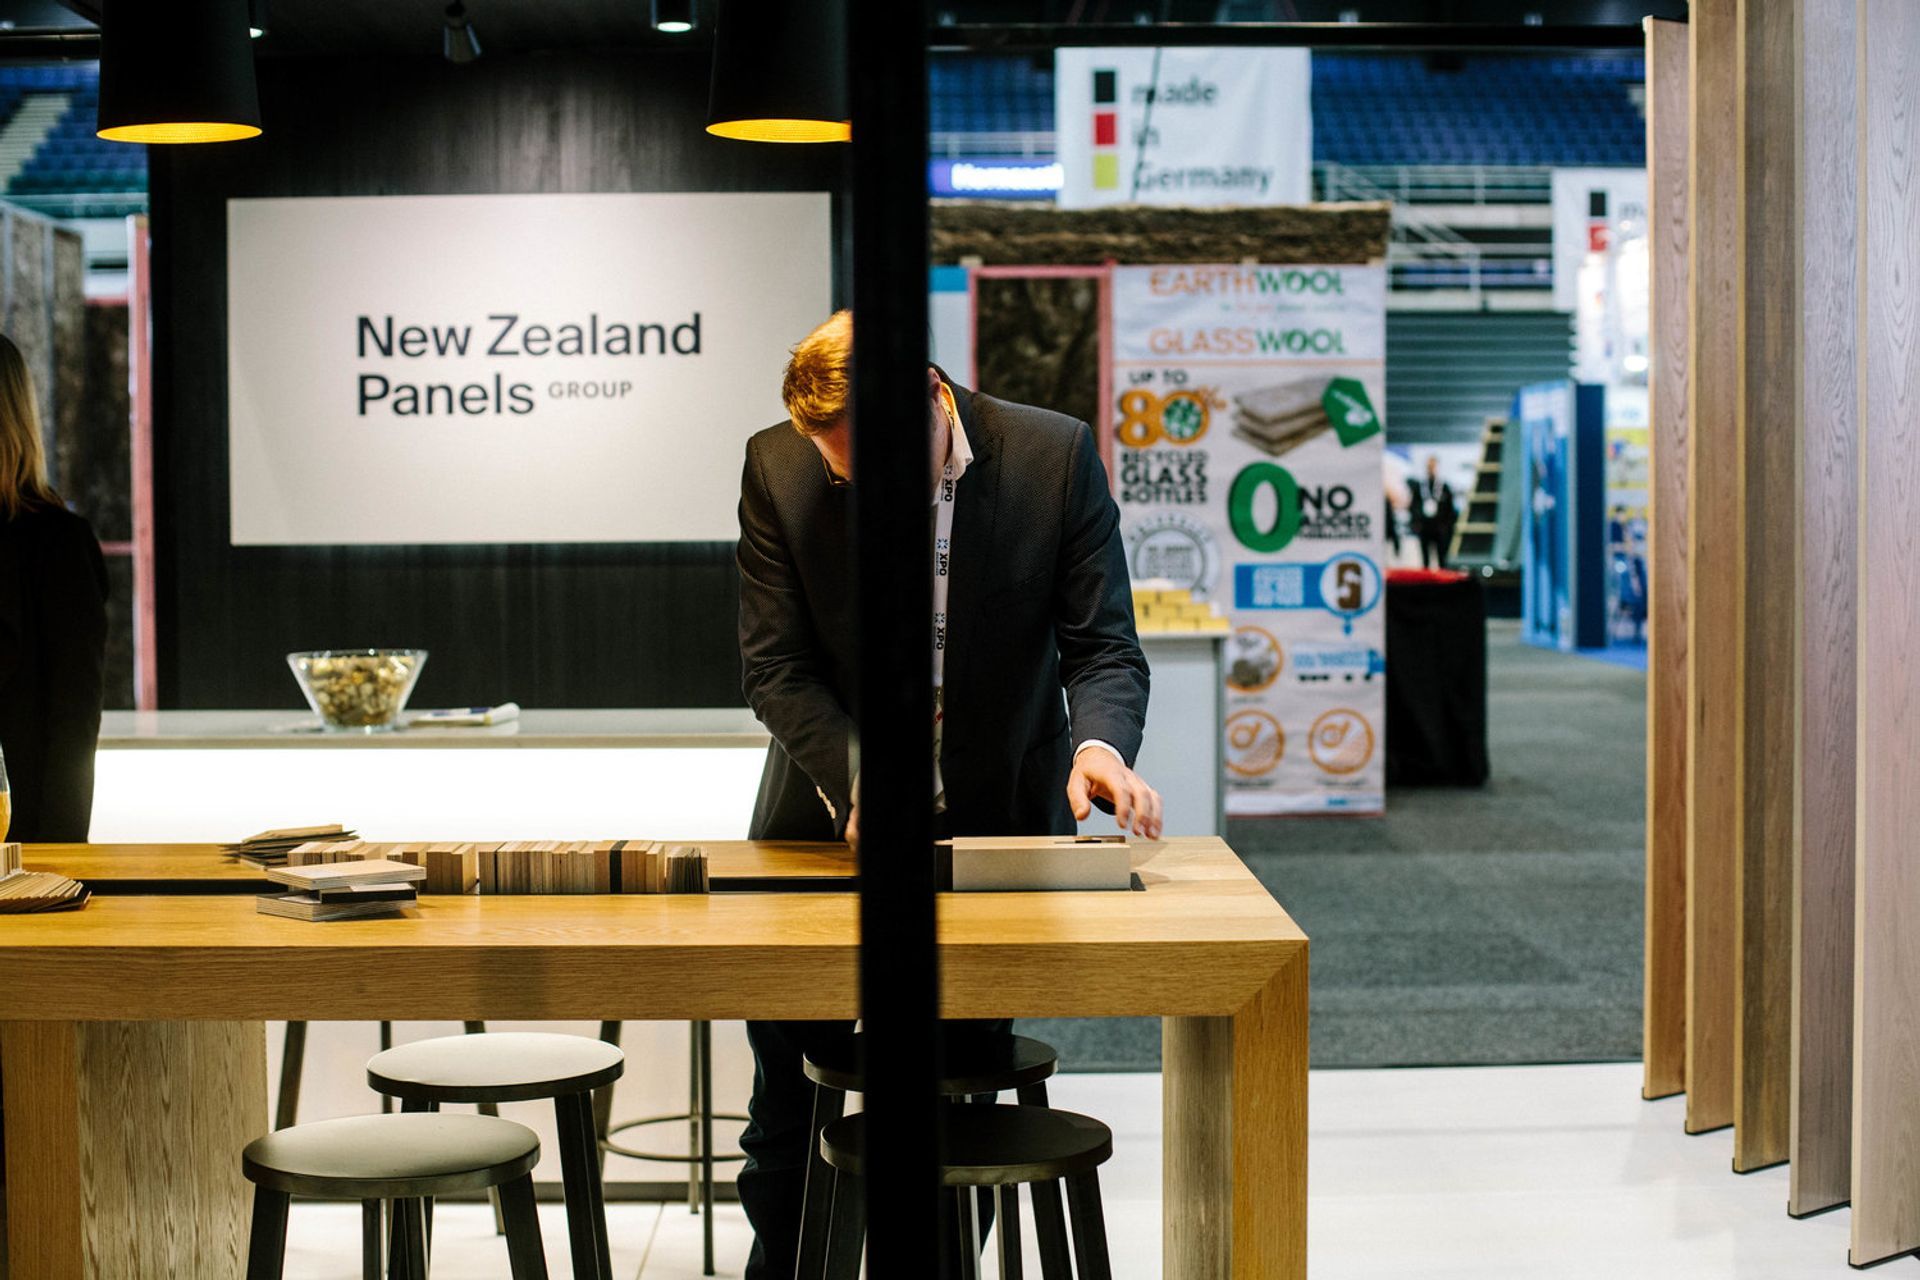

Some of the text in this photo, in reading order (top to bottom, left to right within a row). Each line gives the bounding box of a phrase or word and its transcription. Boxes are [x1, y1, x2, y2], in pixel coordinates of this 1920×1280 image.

[357, 311, 703, 358] New Zealand
[1163, 370, 1187, 384] TO
[357, 372, 633, 417] Panels GROUP
[1121, 464, 1208, 486] GLASS
[944, 478, 953, 502] XPO
[1121, 485, 1208, 505] BOTTLES
[1299, 485, 1354, 512] NO
[939, 553, 949, 576] XPO
[936, 627, 945, 651] XPO
